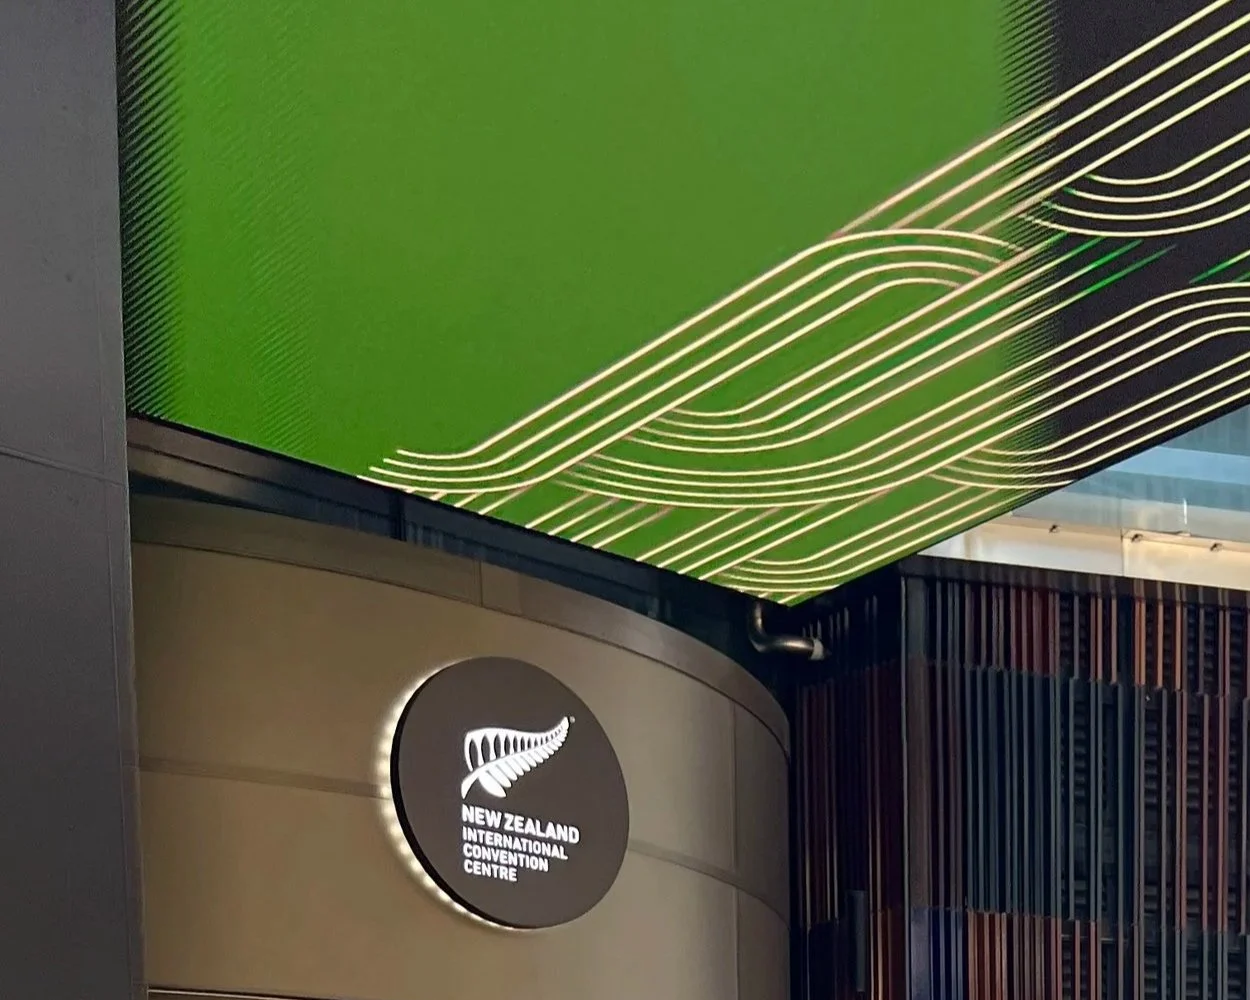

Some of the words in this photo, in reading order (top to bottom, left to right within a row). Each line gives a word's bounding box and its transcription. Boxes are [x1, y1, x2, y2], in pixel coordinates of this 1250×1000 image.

[462, 804, 502, 829] NEW
[503, 812, 580, 844] ZEALAND
[462, 825, 569, 860] INTERNATIONAL
[463, 842, 549, 872] CONVENTION
[463, 858, 518, 882] CENTRE
